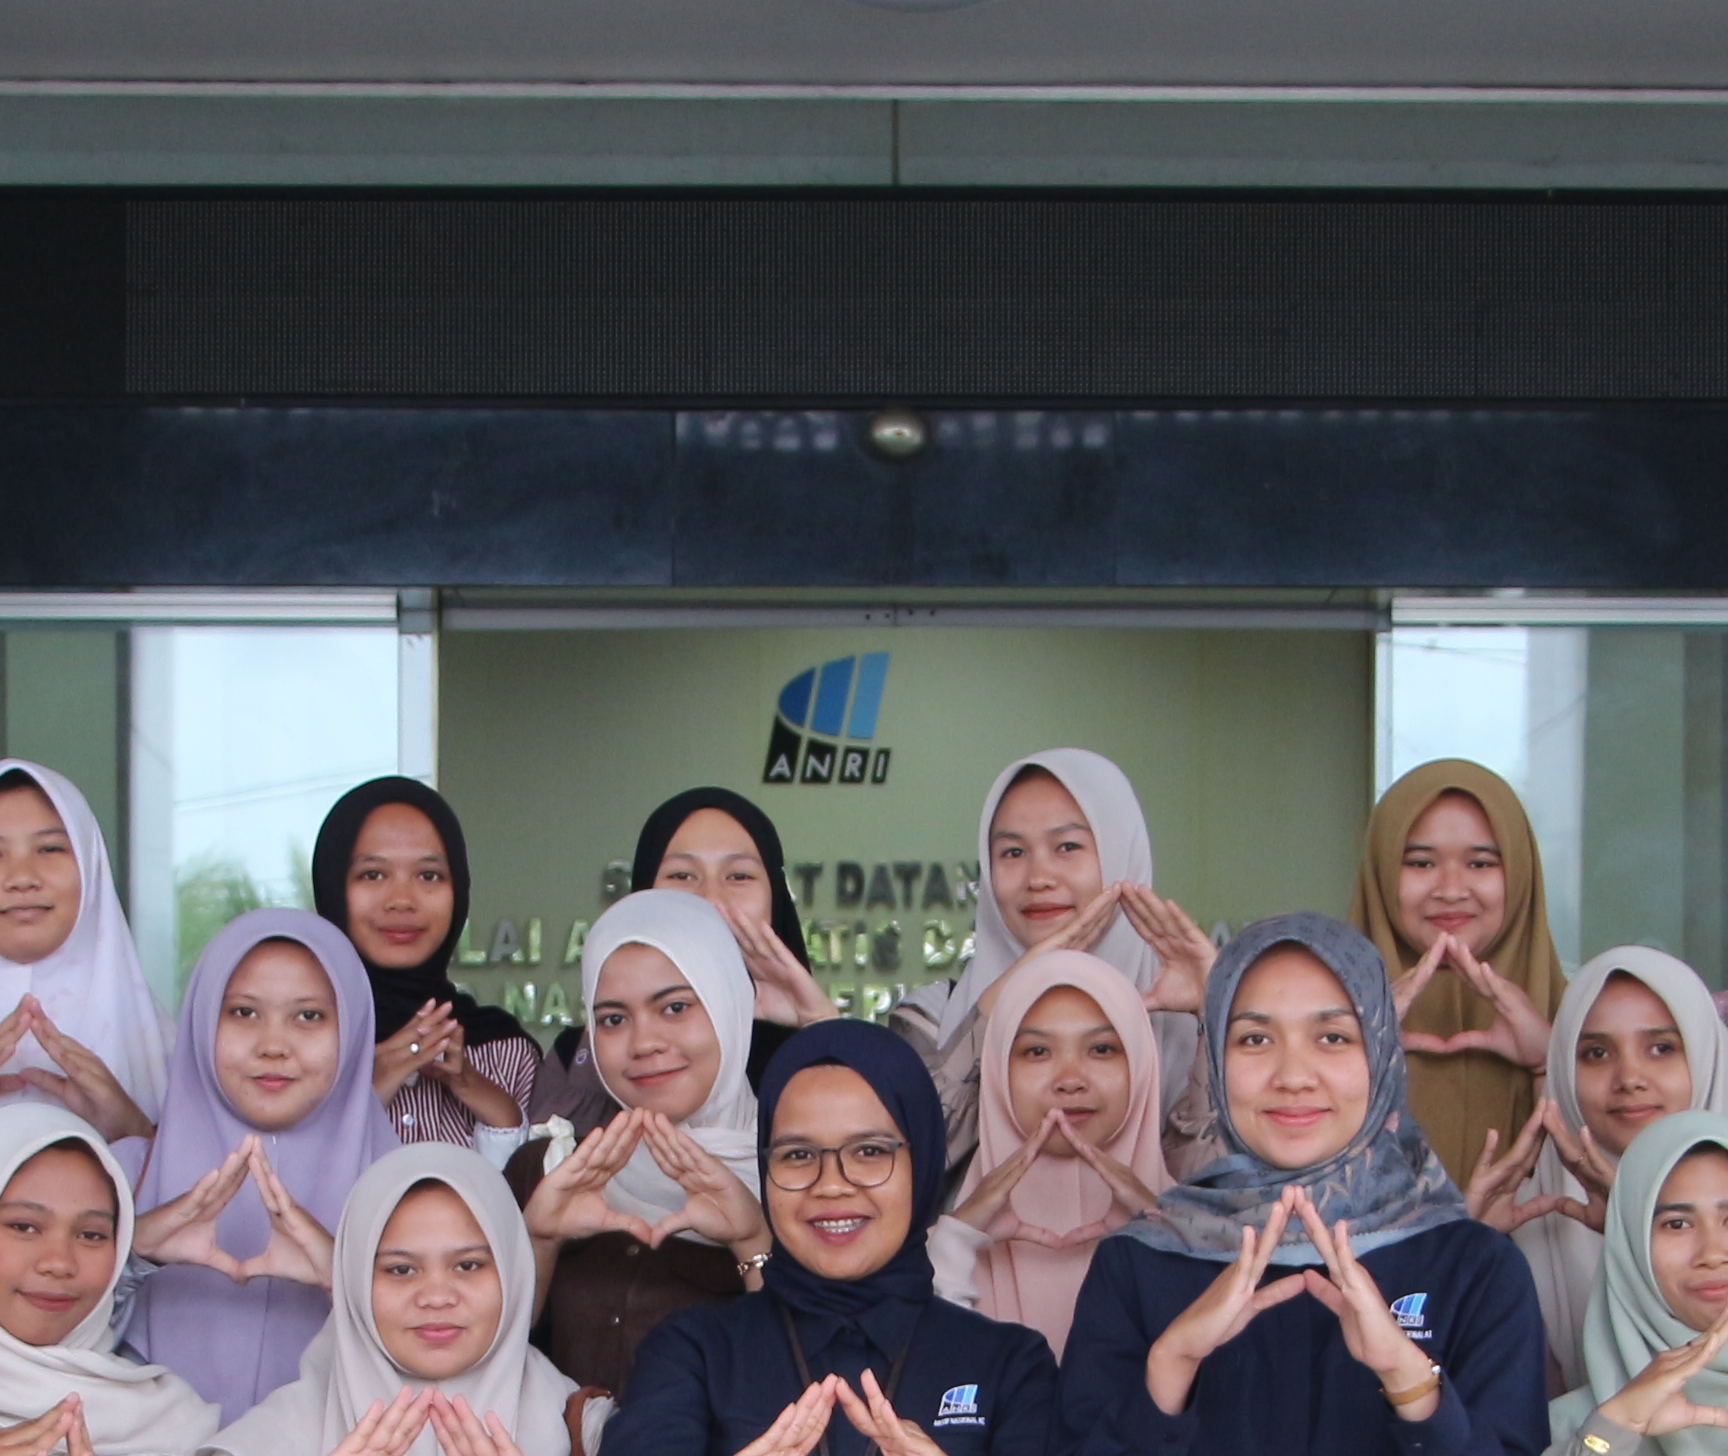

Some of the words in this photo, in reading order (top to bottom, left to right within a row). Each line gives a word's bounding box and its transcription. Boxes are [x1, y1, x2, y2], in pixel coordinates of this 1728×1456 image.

[768, 752, 886, 779] ANRI
[834, 861, 980, 908] DATAN
[457, 917, 543, 965] LAI
